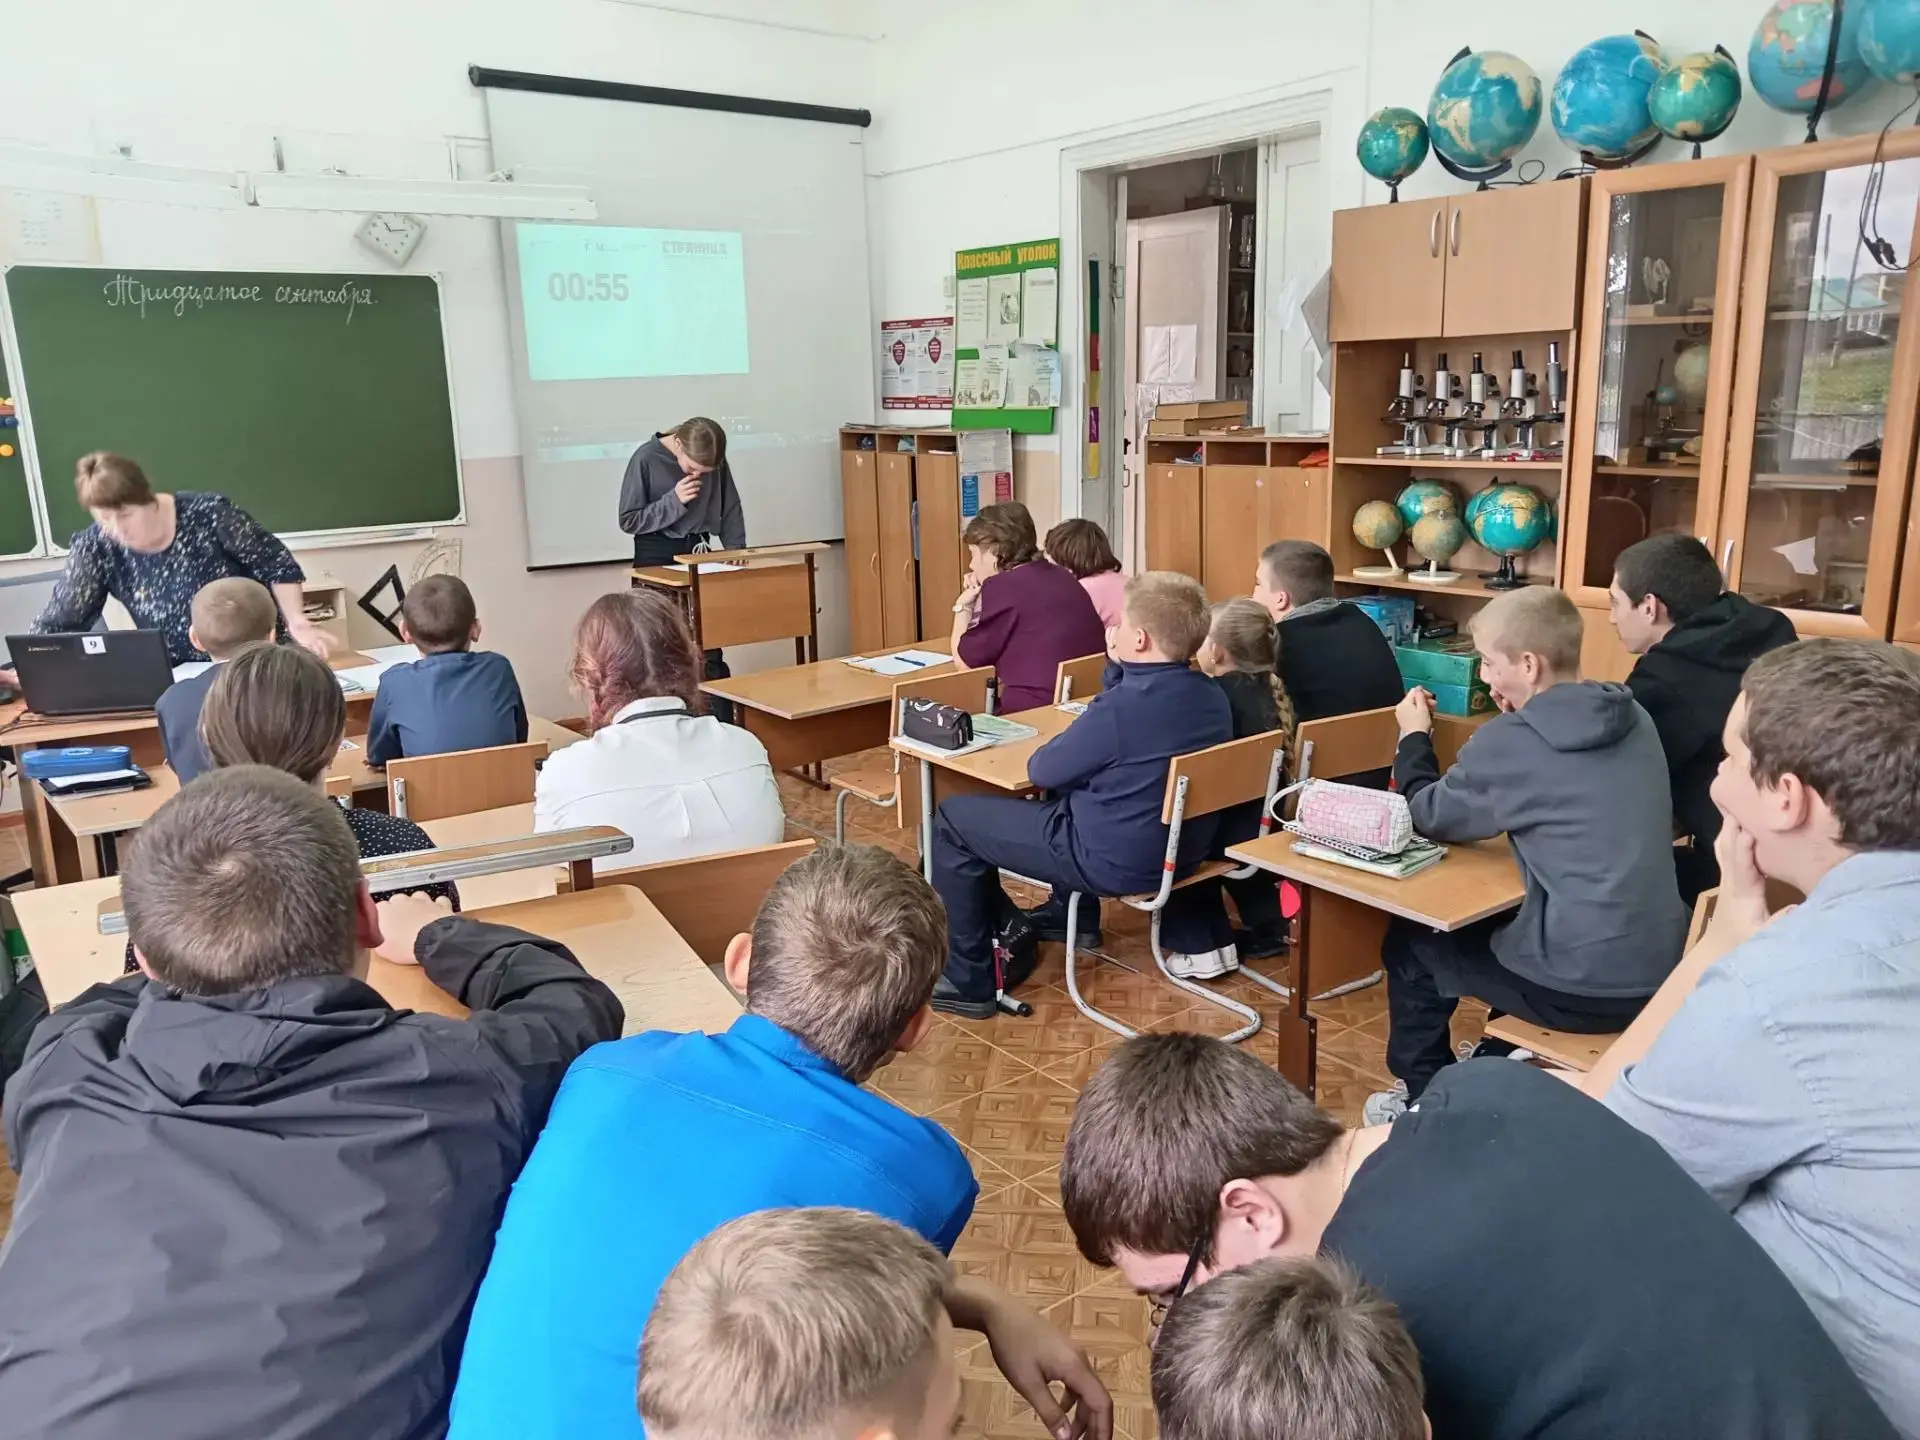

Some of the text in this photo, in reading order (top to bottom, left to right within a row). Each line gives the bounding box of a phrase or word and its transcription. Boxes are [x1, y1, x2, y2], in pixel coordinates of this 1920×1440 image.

[1018, 244, 1056, 264] уголок
[103, 274, 262, 319] Тридцатое
[549, 272, 629, 301] 00:55
[90, 641, 97, 649] 9
